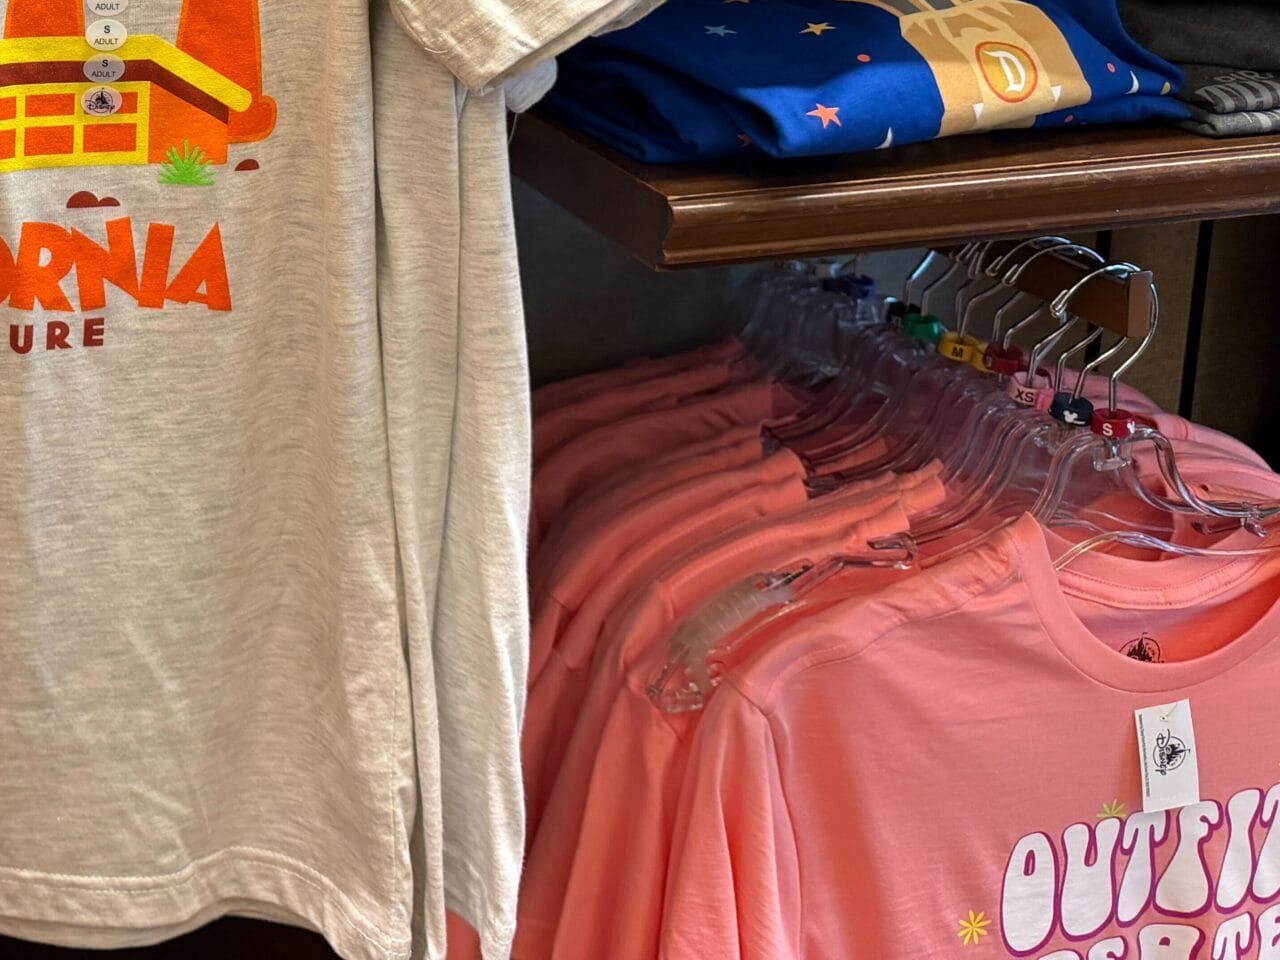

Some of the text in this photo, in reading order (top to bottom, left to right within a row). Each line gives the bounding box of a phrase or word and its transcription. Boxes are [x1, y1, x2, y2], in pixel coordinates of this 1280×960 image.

[104, 25, 111, 34] S
[102, 59, 109, 68] S
[1015, 389, 1035, 403] XS
[1102, 423, 1114, 437] S
[1154, 728, 1171, 776] Disney
